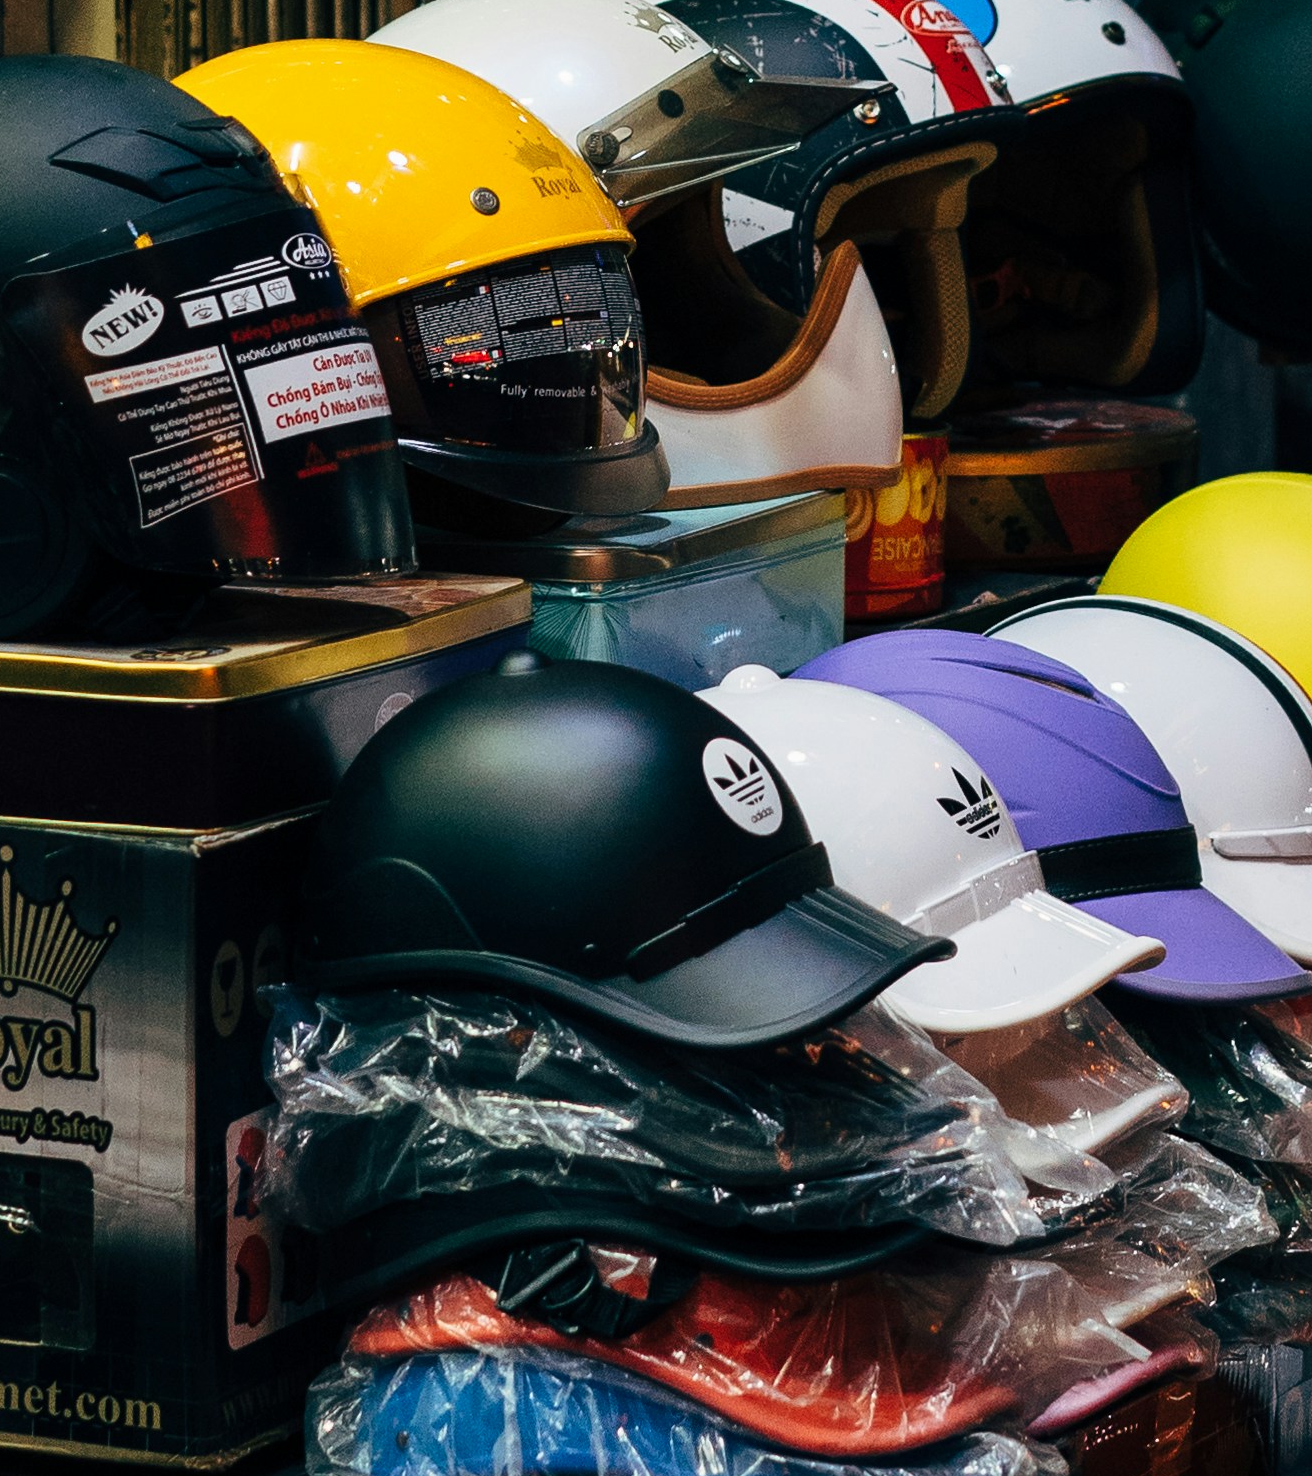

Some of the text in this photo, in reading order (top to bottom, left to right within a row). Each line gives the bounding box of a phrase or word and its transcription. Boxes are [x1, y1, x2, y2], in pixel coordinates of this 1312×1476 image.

[533, 174, 581, 199] Royal
[292, 237, 327, 261] Asia
[87, 297, 161, 351] NEW!
[265, 382, 311, 409] Chống
[533, 385, 586, 399] removable
[274, 404, 319, 431] Chống
[749, 805, 775, 824] adidas
[32, 1112, 47, 1136] &
[44, 1112, 110, 1150] Safety
